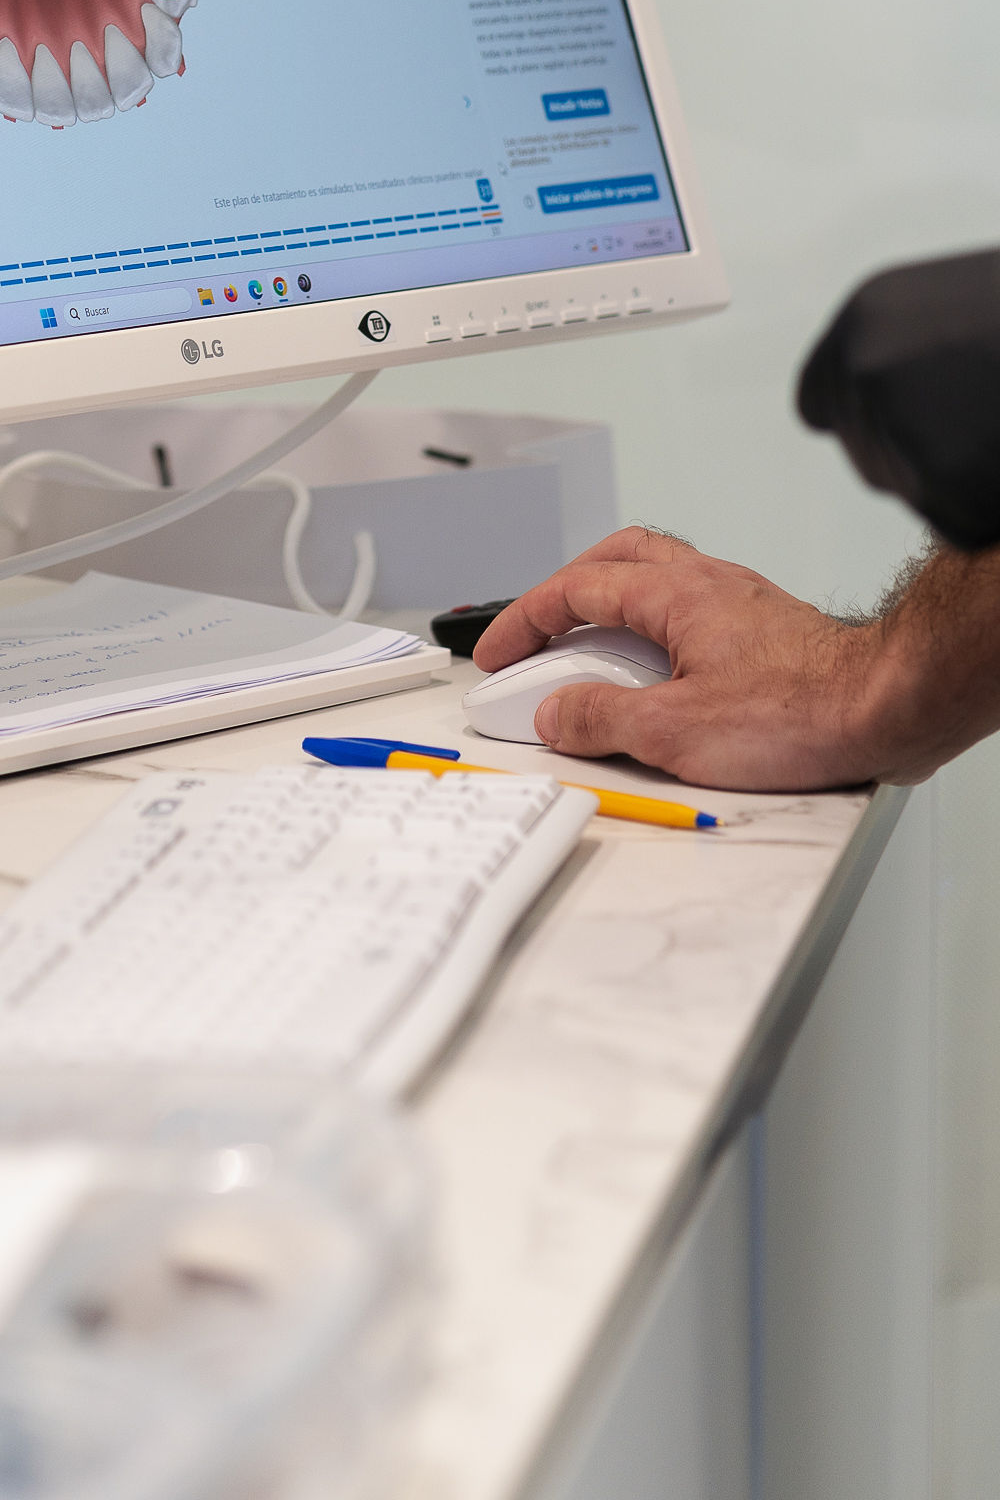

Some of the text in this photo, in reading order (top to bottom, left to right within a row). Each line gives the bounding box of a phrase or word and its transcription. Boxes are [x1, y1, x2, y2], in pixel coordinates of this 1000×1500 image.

[214, 198, 231, 208] Este
[232, 196, 250, 208] plan
[250, 194, 261, 203] de
[262, 190, 307, 202] tratamiento
[308, 189, 317, 197] es
[85, 304, 110, 317] Buscar
[201, 339, 225, 359] LG
